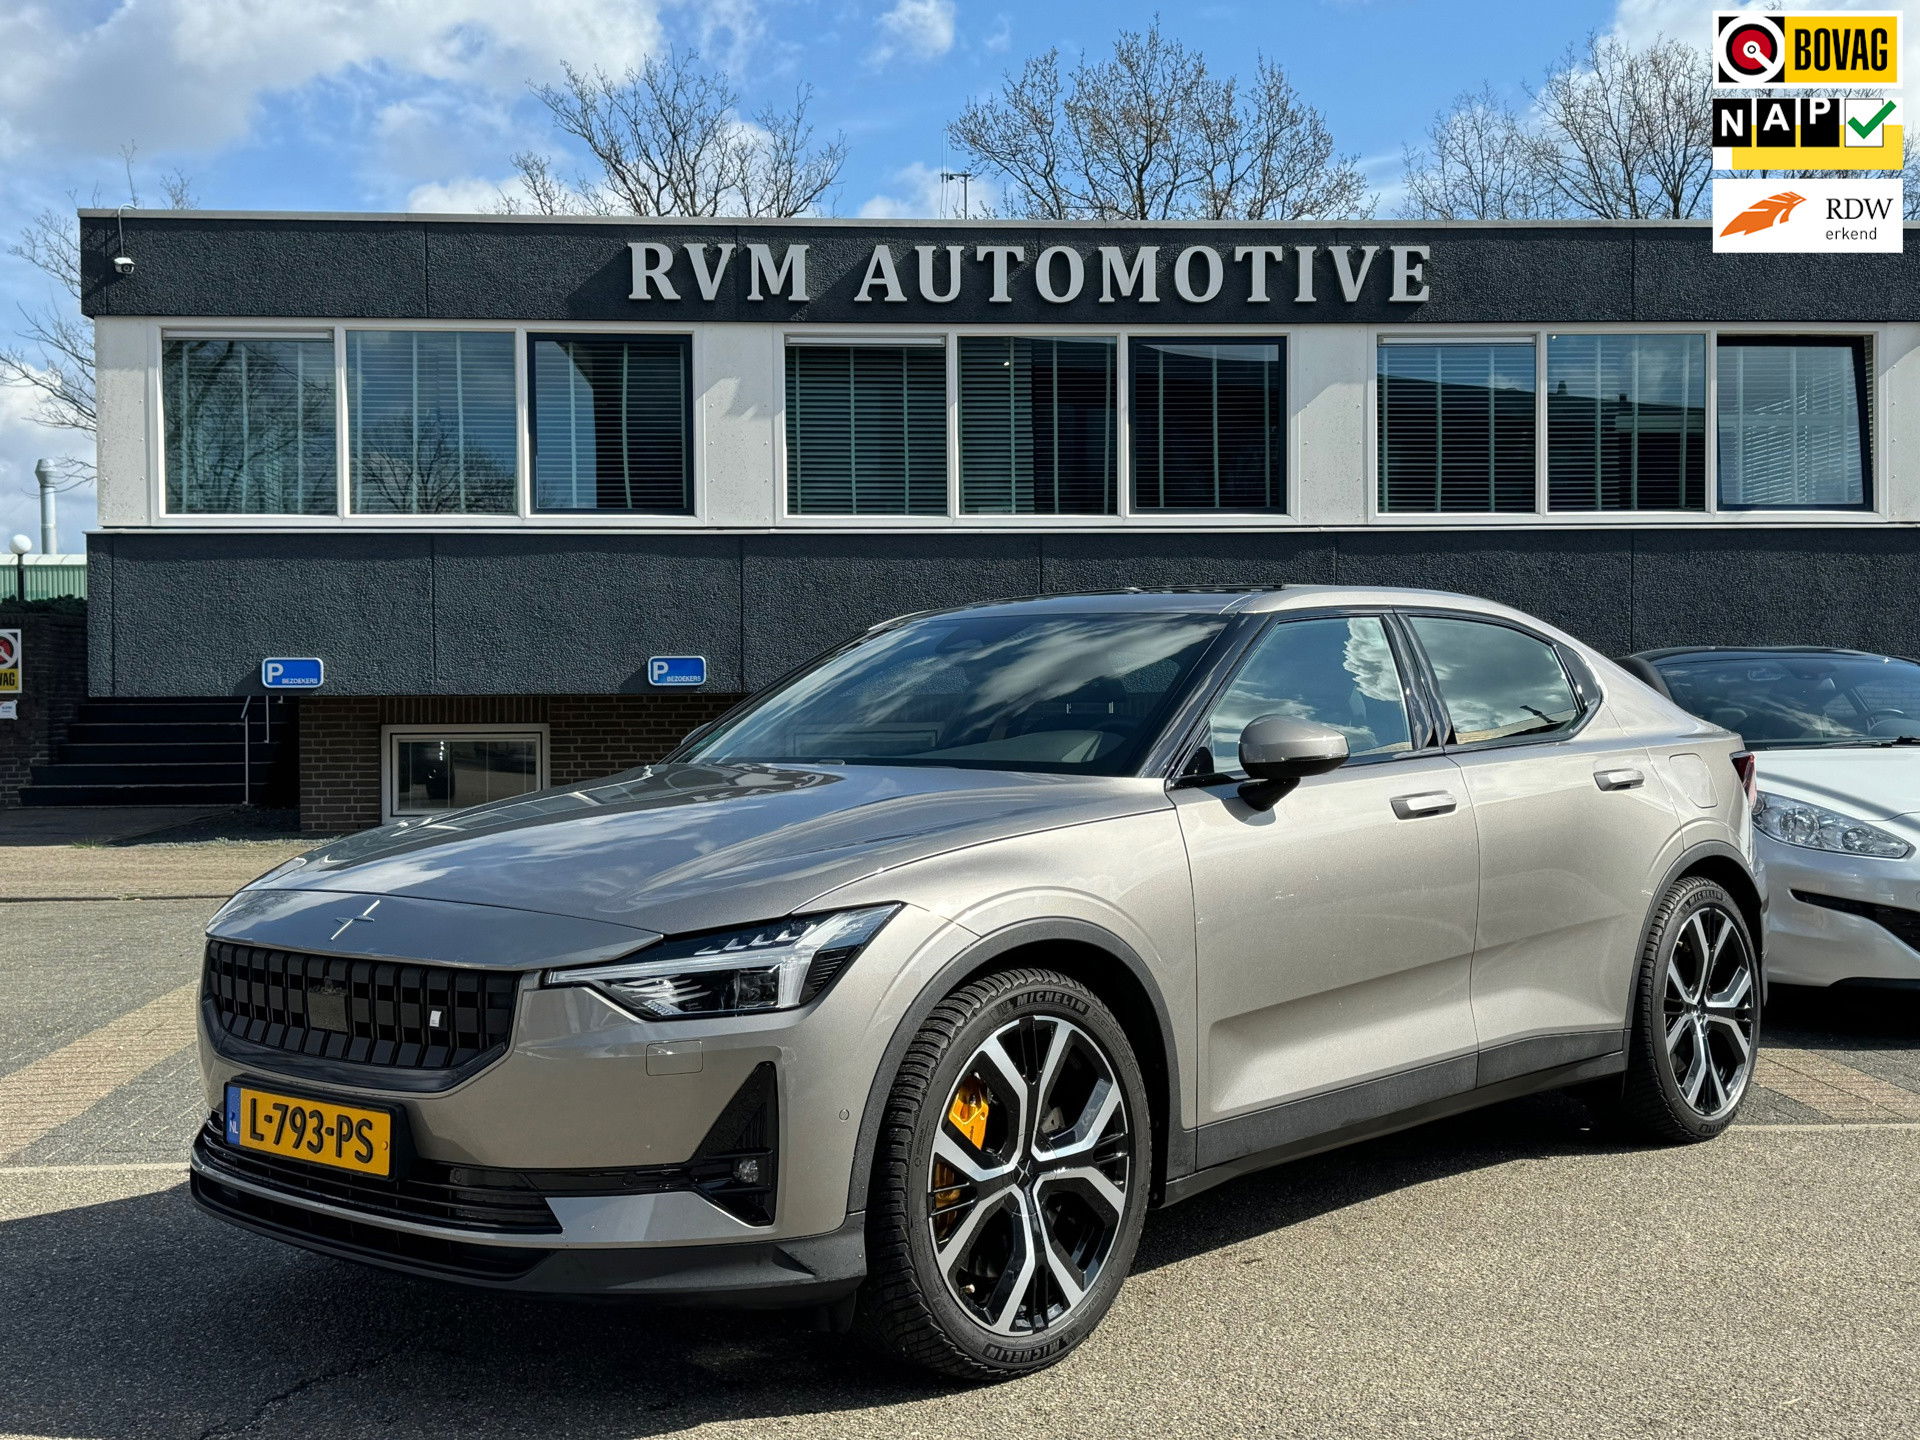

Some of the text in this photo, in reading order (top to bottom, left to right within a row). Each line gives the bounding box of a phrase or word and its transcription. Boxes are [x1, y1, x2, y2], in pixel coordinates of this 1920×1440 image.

[627, 242, 1430, 303] RVM AUTOMOTIVE
[267, 663, 283, 683] P
[652, 661, 669, 681] P
[1017, 991, 1087, 1013] MICHELIN
[229, 1119, 239, 1134] NL
[250, 1098, 374, 1164] L-793-PS
